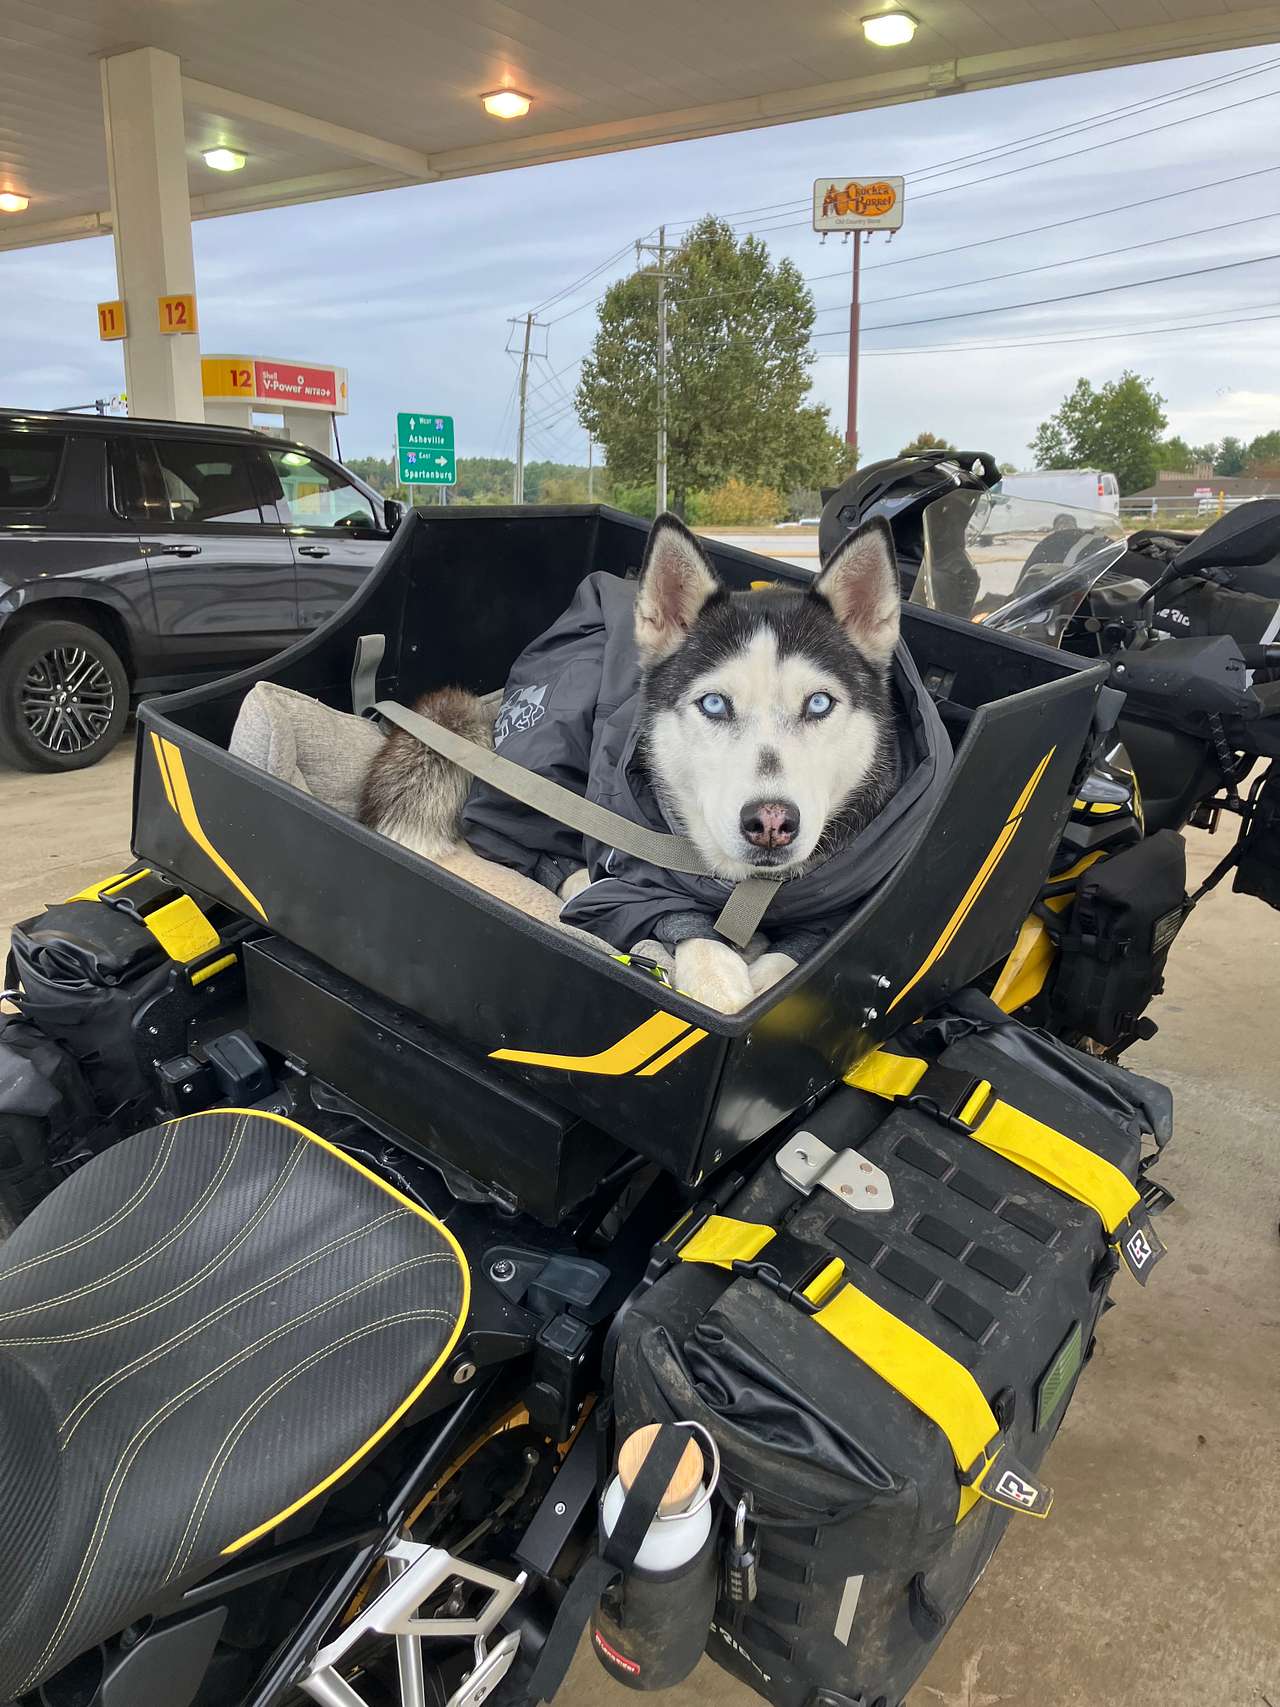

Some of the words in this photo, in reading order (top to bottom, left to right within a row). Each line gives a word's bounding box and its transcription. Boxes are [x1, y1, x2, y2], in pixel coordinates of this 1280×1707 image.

[100, 309, 115, 331] 11
[165, 302, 187, 325] 12
[230, 369, 252, 387] 12
[262, 370, 278, 380] Shell
[263, 380, 302, 393] V-Power
[408, 434, 445, 445] Asheville
[404, 468, 453, 481] Spartanburg
